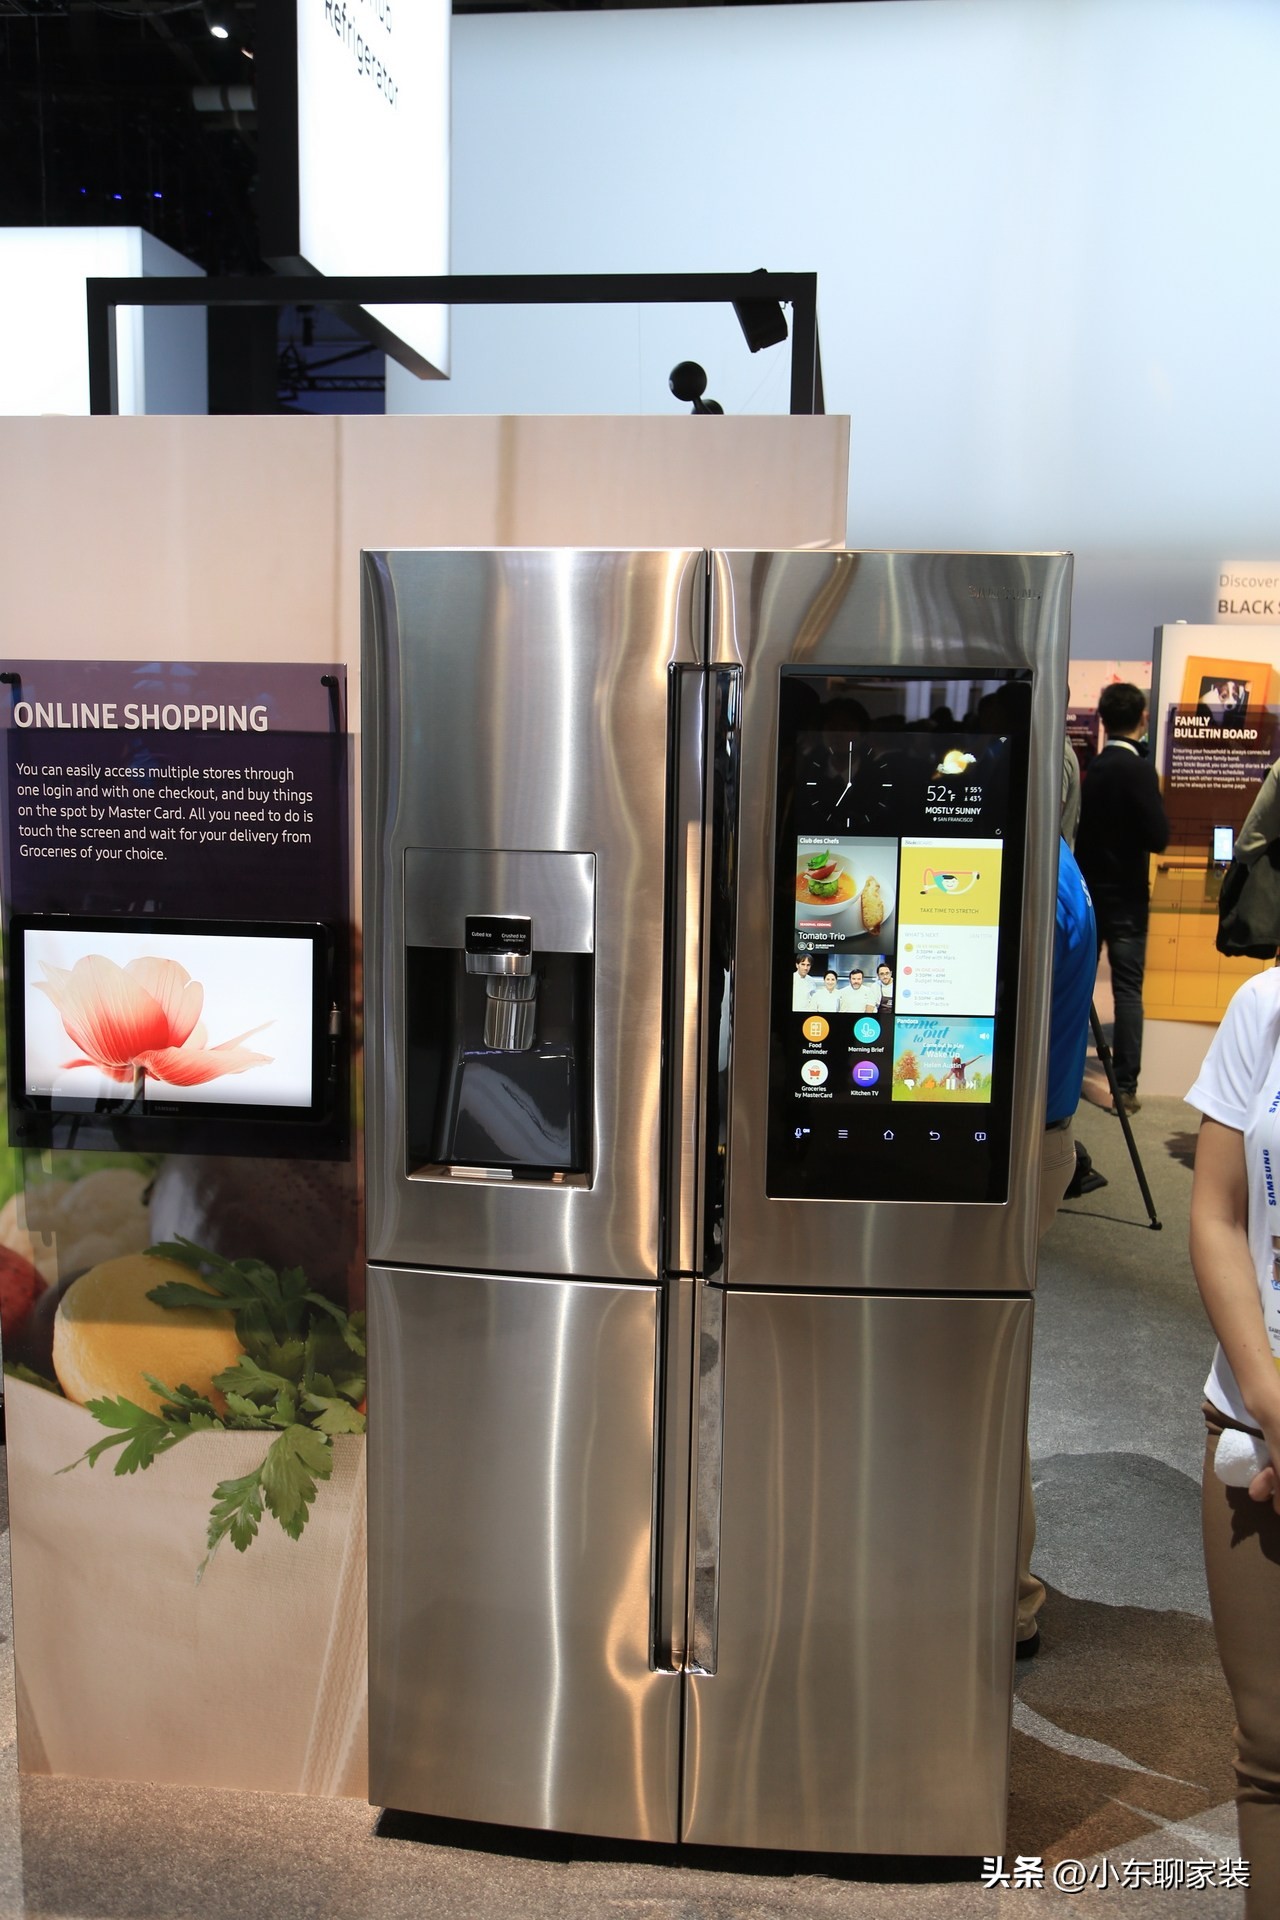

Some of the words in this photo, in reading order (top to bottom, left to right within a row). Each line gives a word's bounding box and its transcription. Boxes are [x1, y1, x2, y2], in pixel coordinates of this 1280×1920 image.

[1219, 574, 1280, 588] Discover
[1218, 599, 1274, 615] BLACK
[13, 702, 119, 729] ONLINE
[123, 703, 269, 732] SHOPPING
[1174, 716, 1210, 727] FAMILY
[1174, 728, 1220, 739] BULLETIN
[1222, 729, 1258, 740] BOARD
[16, 762, 38, 775] You
[41, 765, 63, 776] can
[66, 763, 101, 780] easily
[104, 767, 145, 778] access
[148, 765, 199, 781] multiple
[203, 767, 241, 780] stores
[244, 766, 294, 783] through
[17, 785, 40, 796] one
[43, 783, 73, 800] login
[76, 784, 99, 798] and
[101, 785, 129, 798] with
[132, 788, 155, 799] one
[158, 786, 218, 802] checkout,
[221, 787, 244, 801] and
[247, 788, 270, 803] buy
[273, 788, 313, 804] things
[18, 806, 33, 817] on
[36, 804, 57, 817] the
[60, 805, 87, 820] spot
[90, 805, 105, 821] by
[108, 806, 151, 819] Master
[154, 807, 186, 820] Card.
[188, 807, 206, 821] All
[208, 810, 231, 823] you
[234, 808, 265, 822] need
[267, 809, 281, 822] to
[284, 809, 300, 823] do
[303, 810, 314, 823] is
[925, 806, 954, 814] MOSTLY
[955, 807, 982, 815] SUNNY
[18, 824, 53, 837] touch
[56, 824, 77, 838] the
[80, 828, 121, 839] screen
[124, 826, 147, 840] and
[149, 827, 177, 840] wait
[179, 827, 198, 841] for
[199, 831, 227, 844] your
[229, 828, 279, 845] delivery
[281, 829, 312, 843] from
[19, 844, 77, 859] Groceries
[80, 845, 93, 859] of
[95, 849, 123, 862] your
[125, 846, 167, 861] choice.
[798, 932, 828, 940] Tomato
[830, 932, 846, 940] Trio
[1262, 1149, 1277, 1206] SAMSUNG
